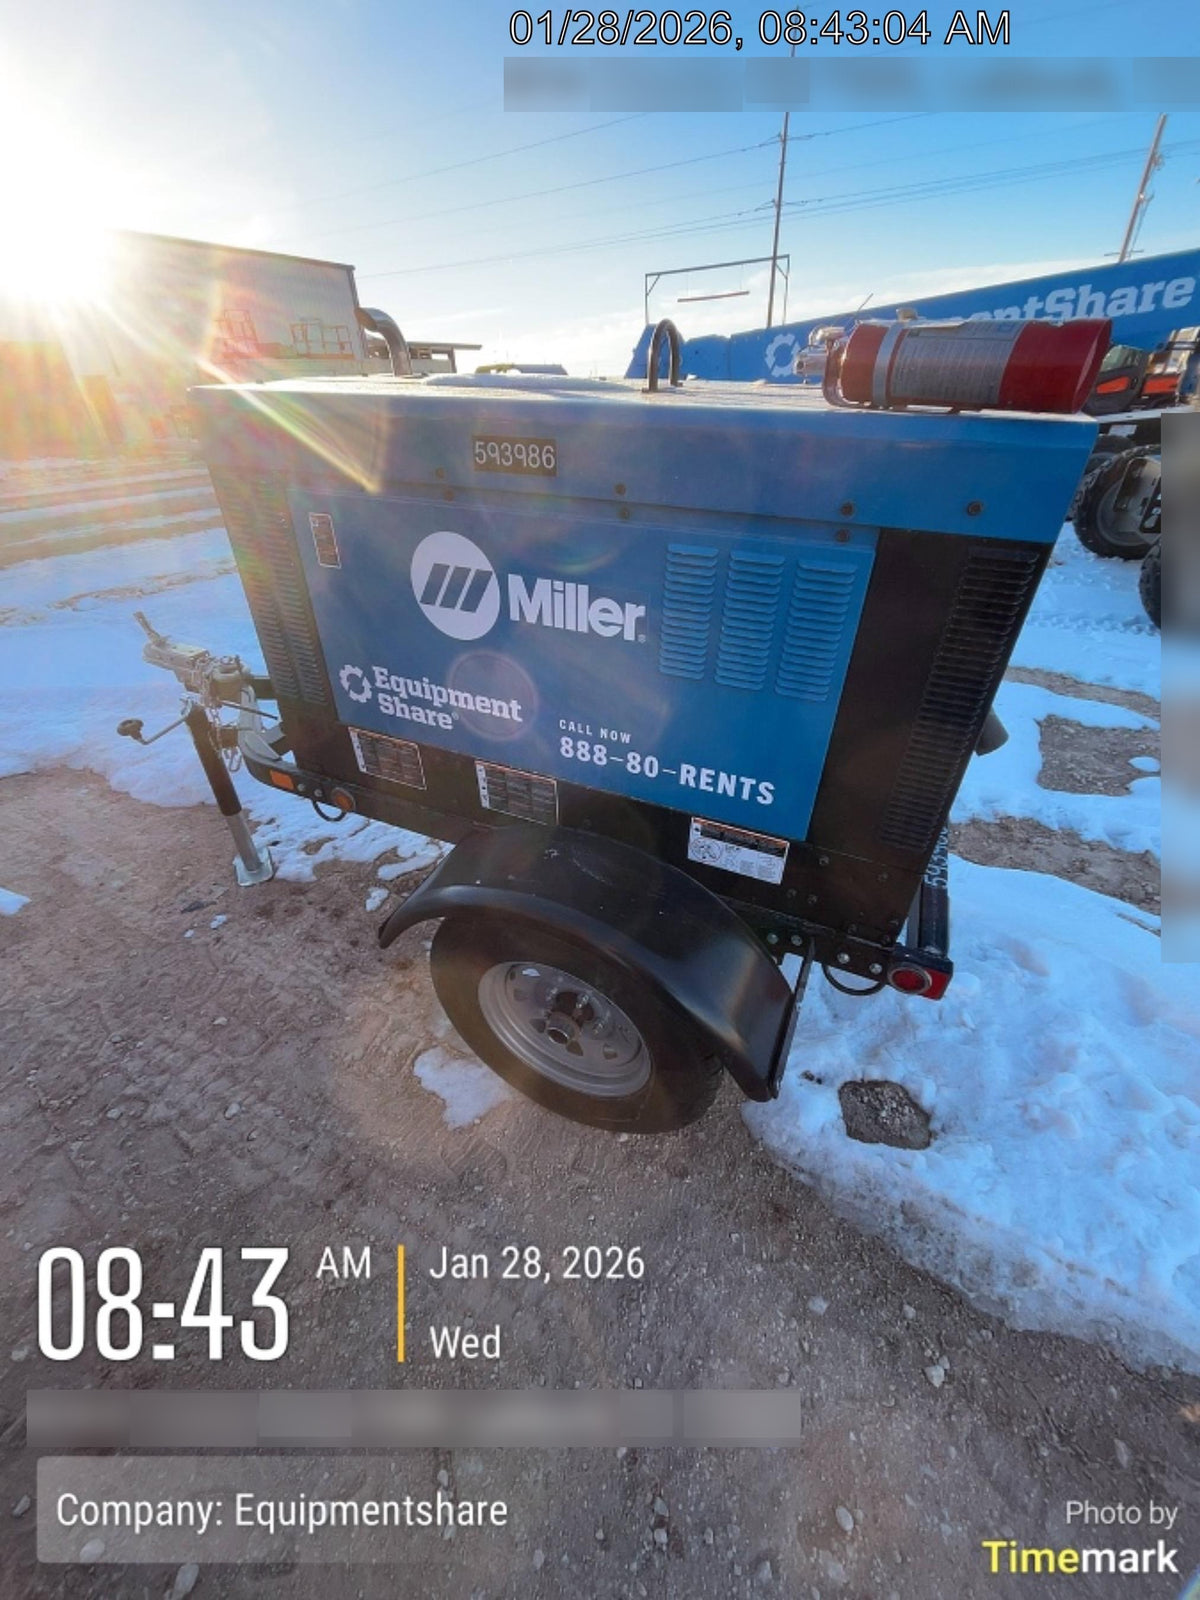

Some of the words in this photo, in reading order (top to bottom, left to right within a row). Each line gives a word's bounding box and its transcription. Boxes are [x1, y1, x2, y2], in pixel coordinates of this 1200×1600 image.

[475, 441, 555, 469] 593986
[508, 573, 646, 642] Miller
[372, 665, 523, 722] Equipment
[559, 719, 593, 736] CALL
[600, 727, 632, 744] NOW
[559, 736, 776, 806] 888-80-RENTS
